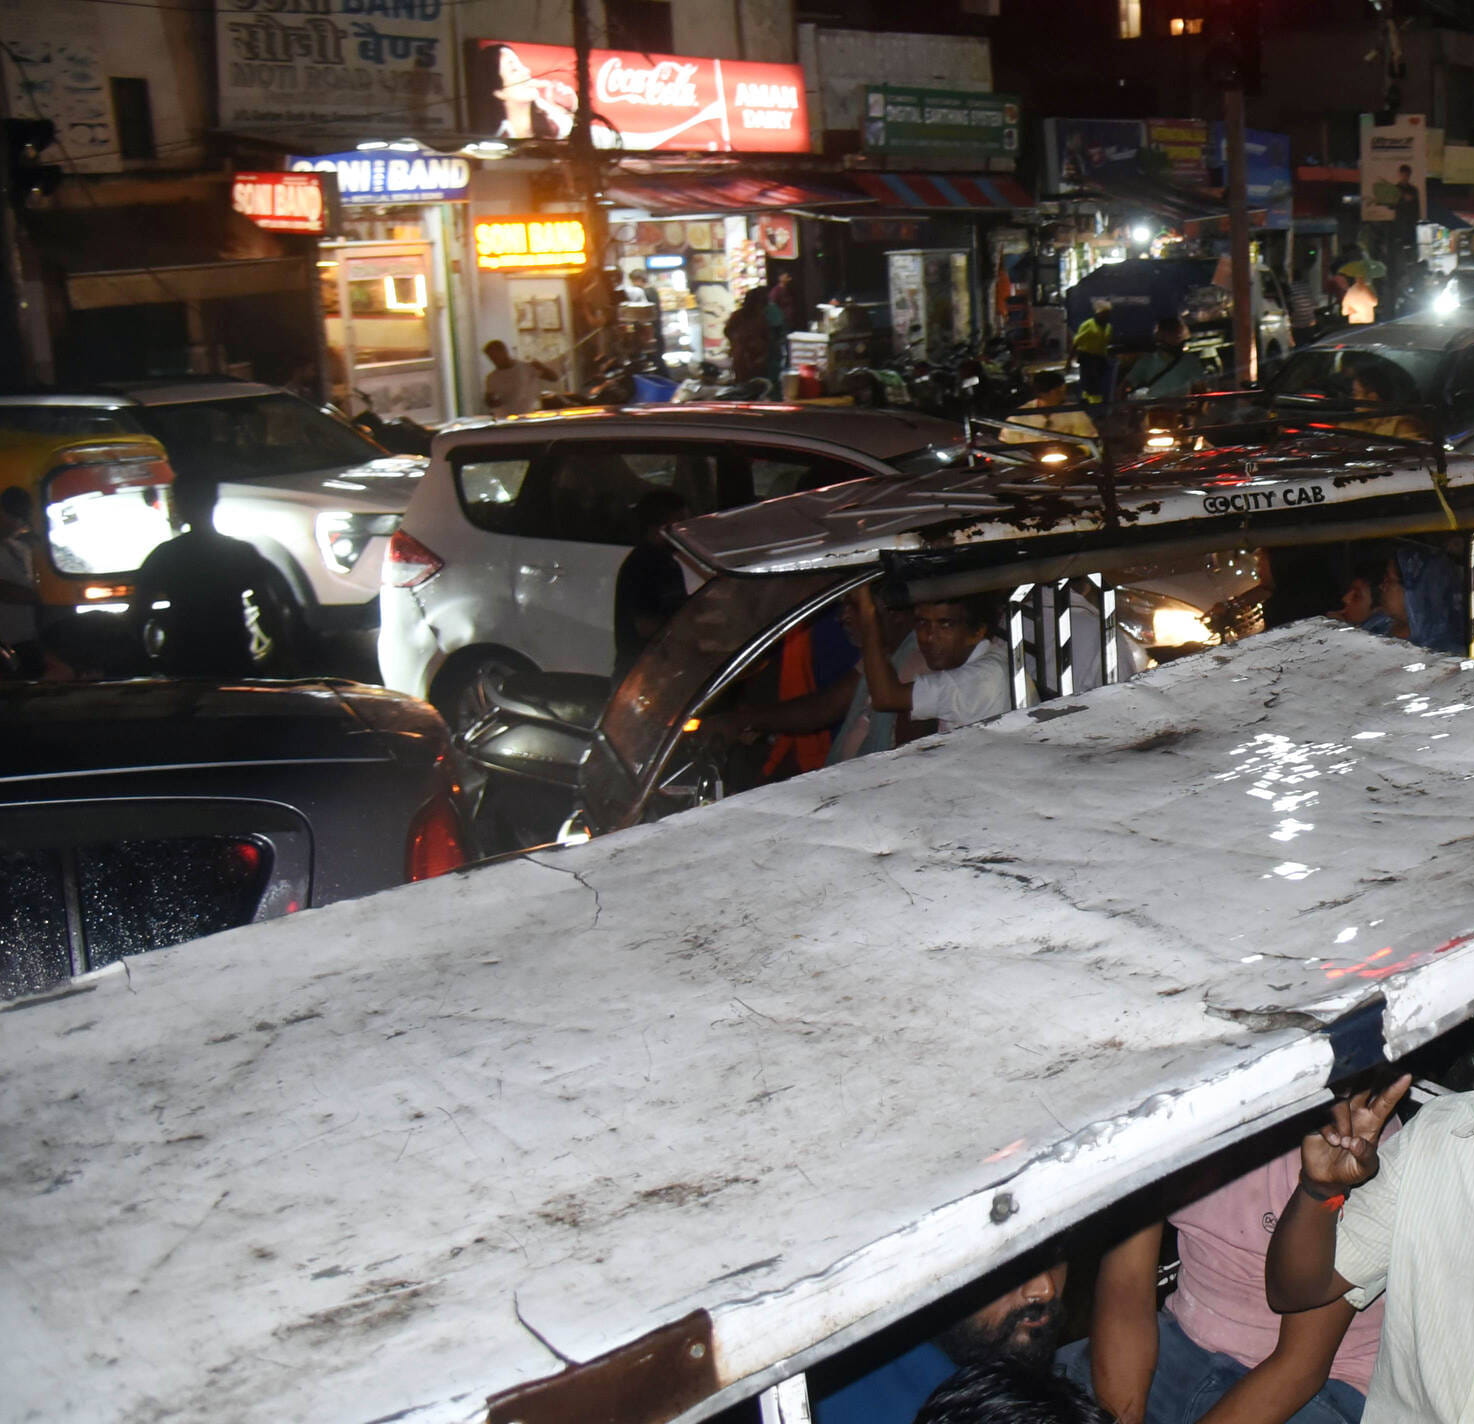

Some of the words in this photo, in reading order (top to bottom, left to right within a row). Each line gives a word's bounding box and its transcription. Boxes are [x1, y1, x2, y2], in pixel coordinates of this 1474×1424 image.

[388, 158, 470, 191] BAND
[1230, 491, 1274, 512] CITY
[1282, 486, 1326, 506] CAB
